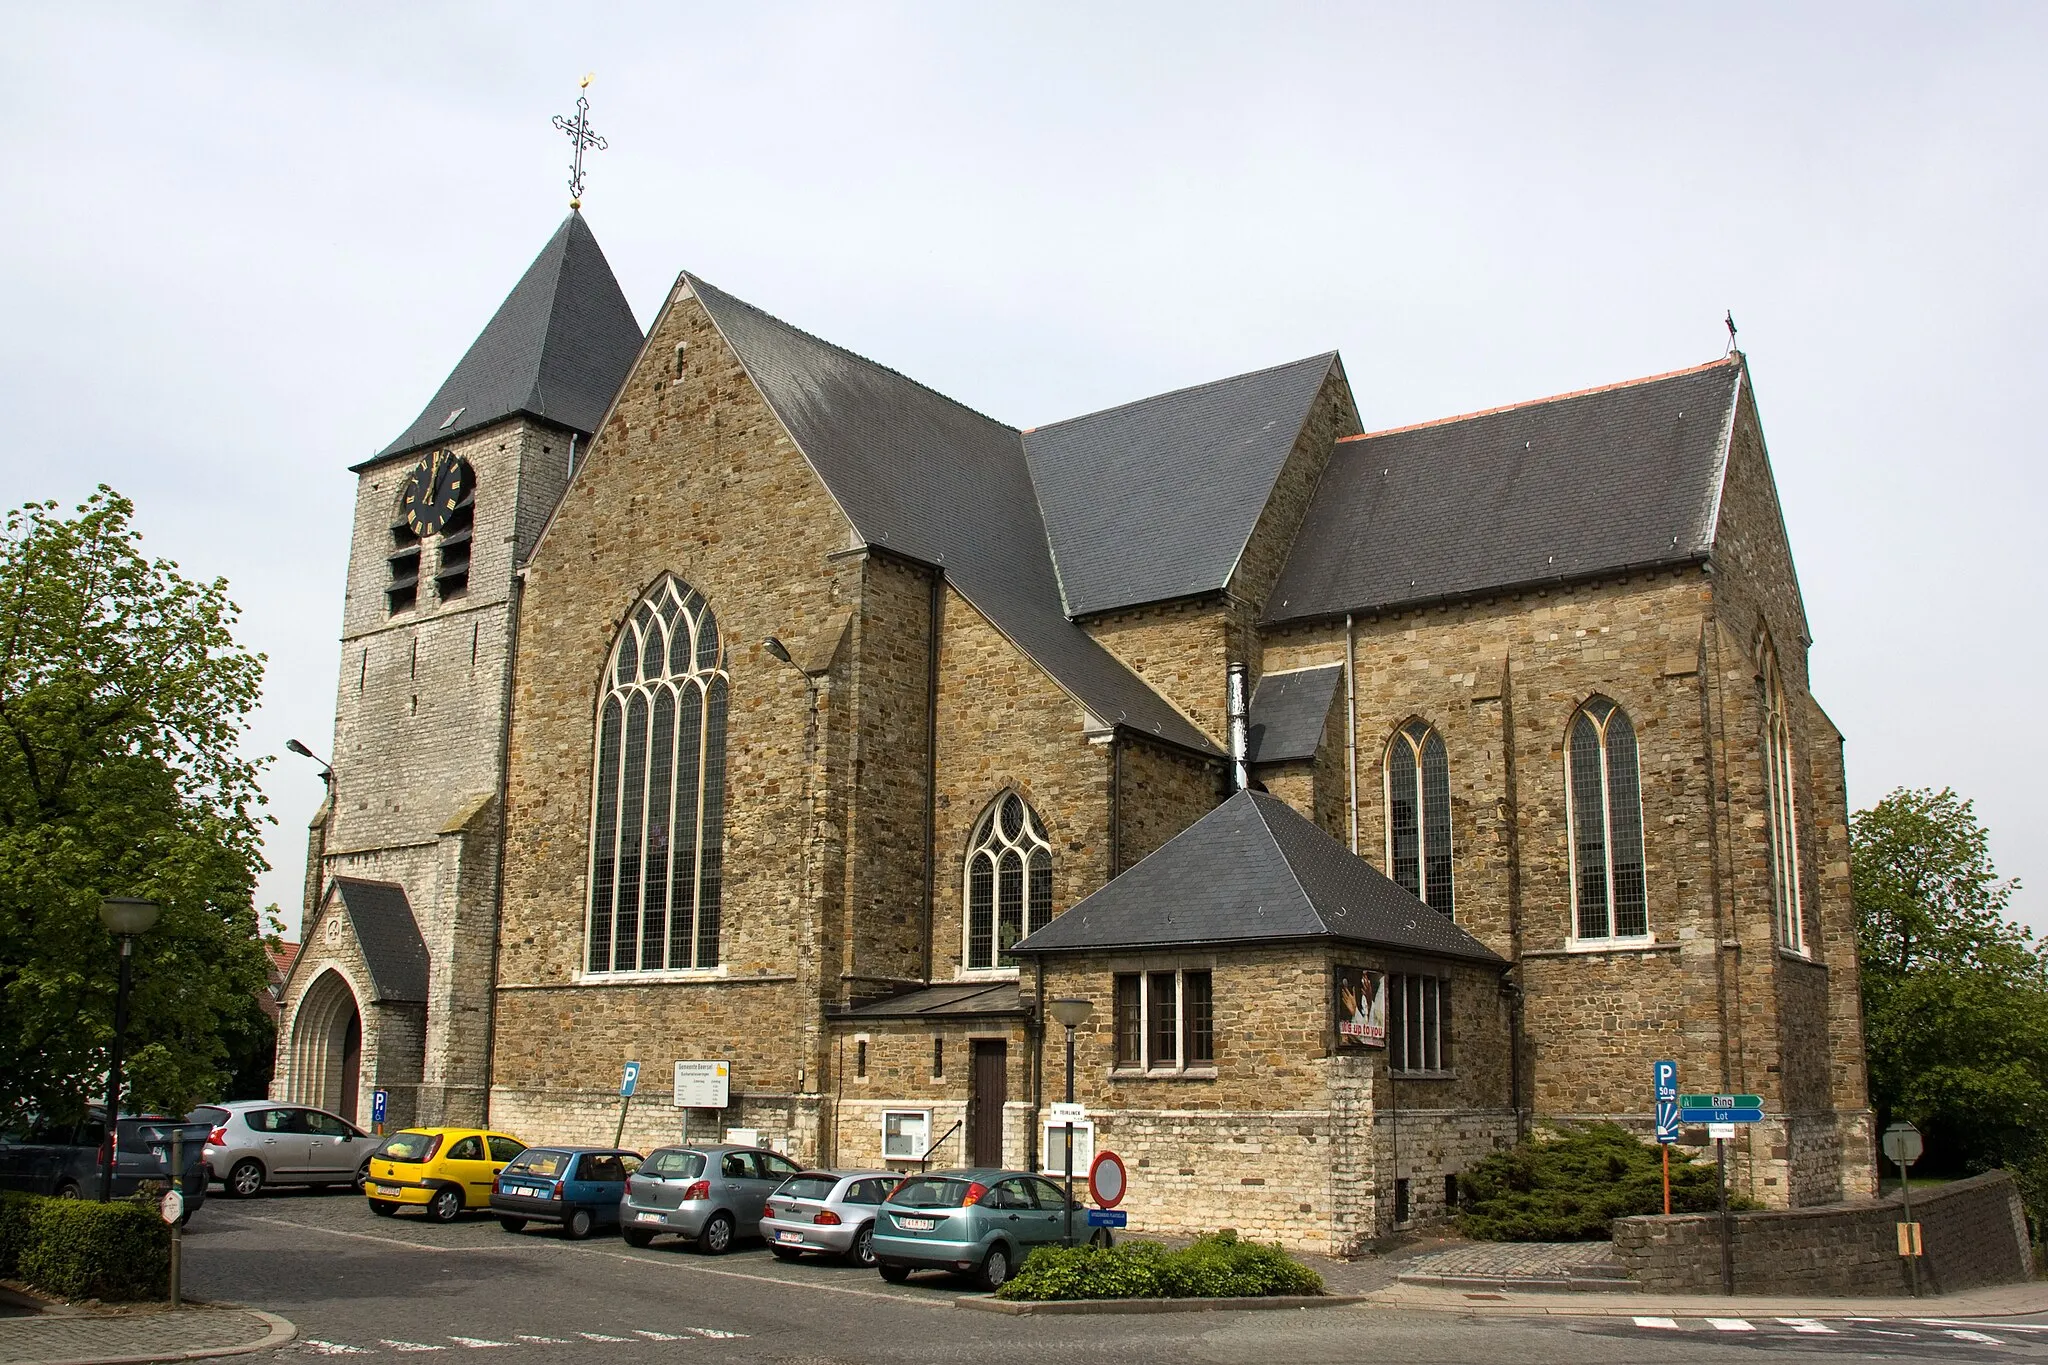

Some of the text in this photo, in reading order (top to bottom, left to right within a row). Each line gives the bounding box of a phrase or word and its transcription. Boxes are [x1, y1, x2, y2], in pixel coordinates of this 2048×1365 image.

[1353, 1024, 1362, 1036] up
[1363, 1024, 1371, 1035] to
[1371, 1026, 1383, 1038] you
[622, 1066, 637, 1091] P
[1660, 1064, 1673, 1087] P
[1659, 1086, 1676, 1096] 50 m
[375, 1093, 384, 1110] P
[1713, 1096, 1733, 1108] Ring
[1715, 1111, 1729, 1120] Lot
